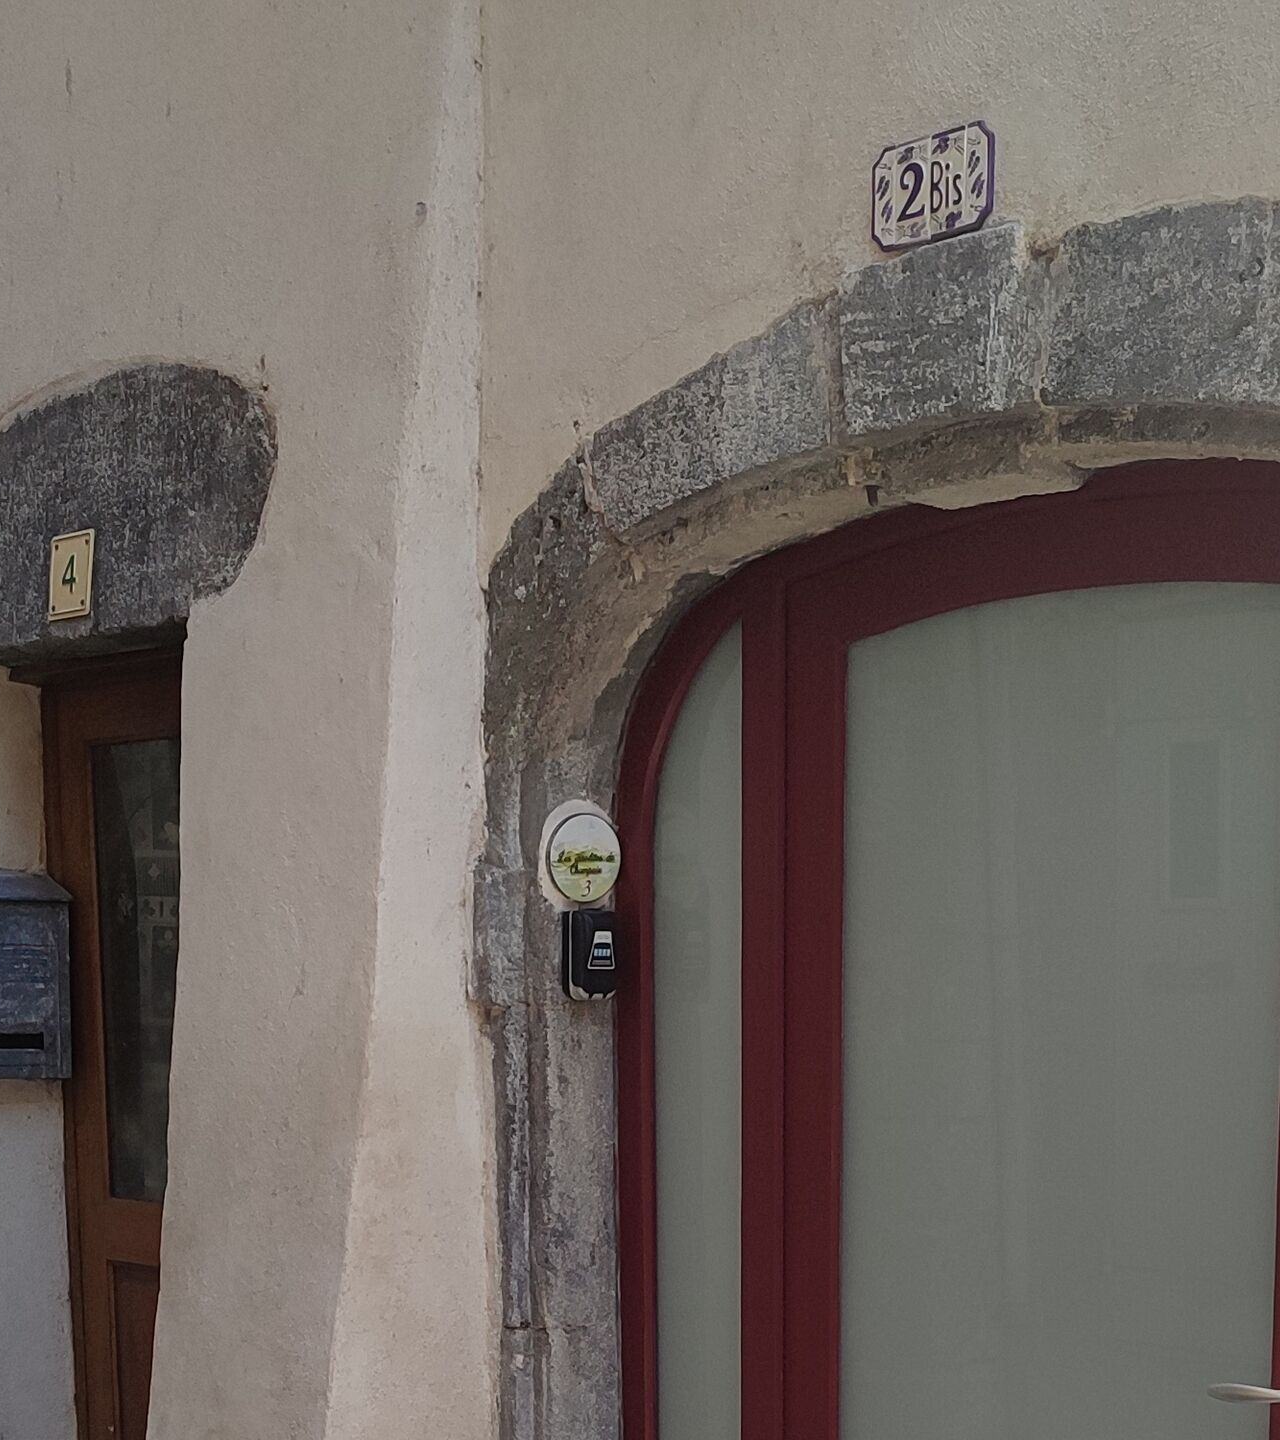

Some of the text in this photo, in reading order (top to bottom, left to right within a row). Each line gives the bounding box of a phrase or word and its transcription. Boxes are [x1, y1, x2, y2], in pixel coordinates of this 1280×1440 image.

[897, 162, 926, 222] 2
[61, 554, 78, 594] 4
[580, 879, 592, 898] 3
